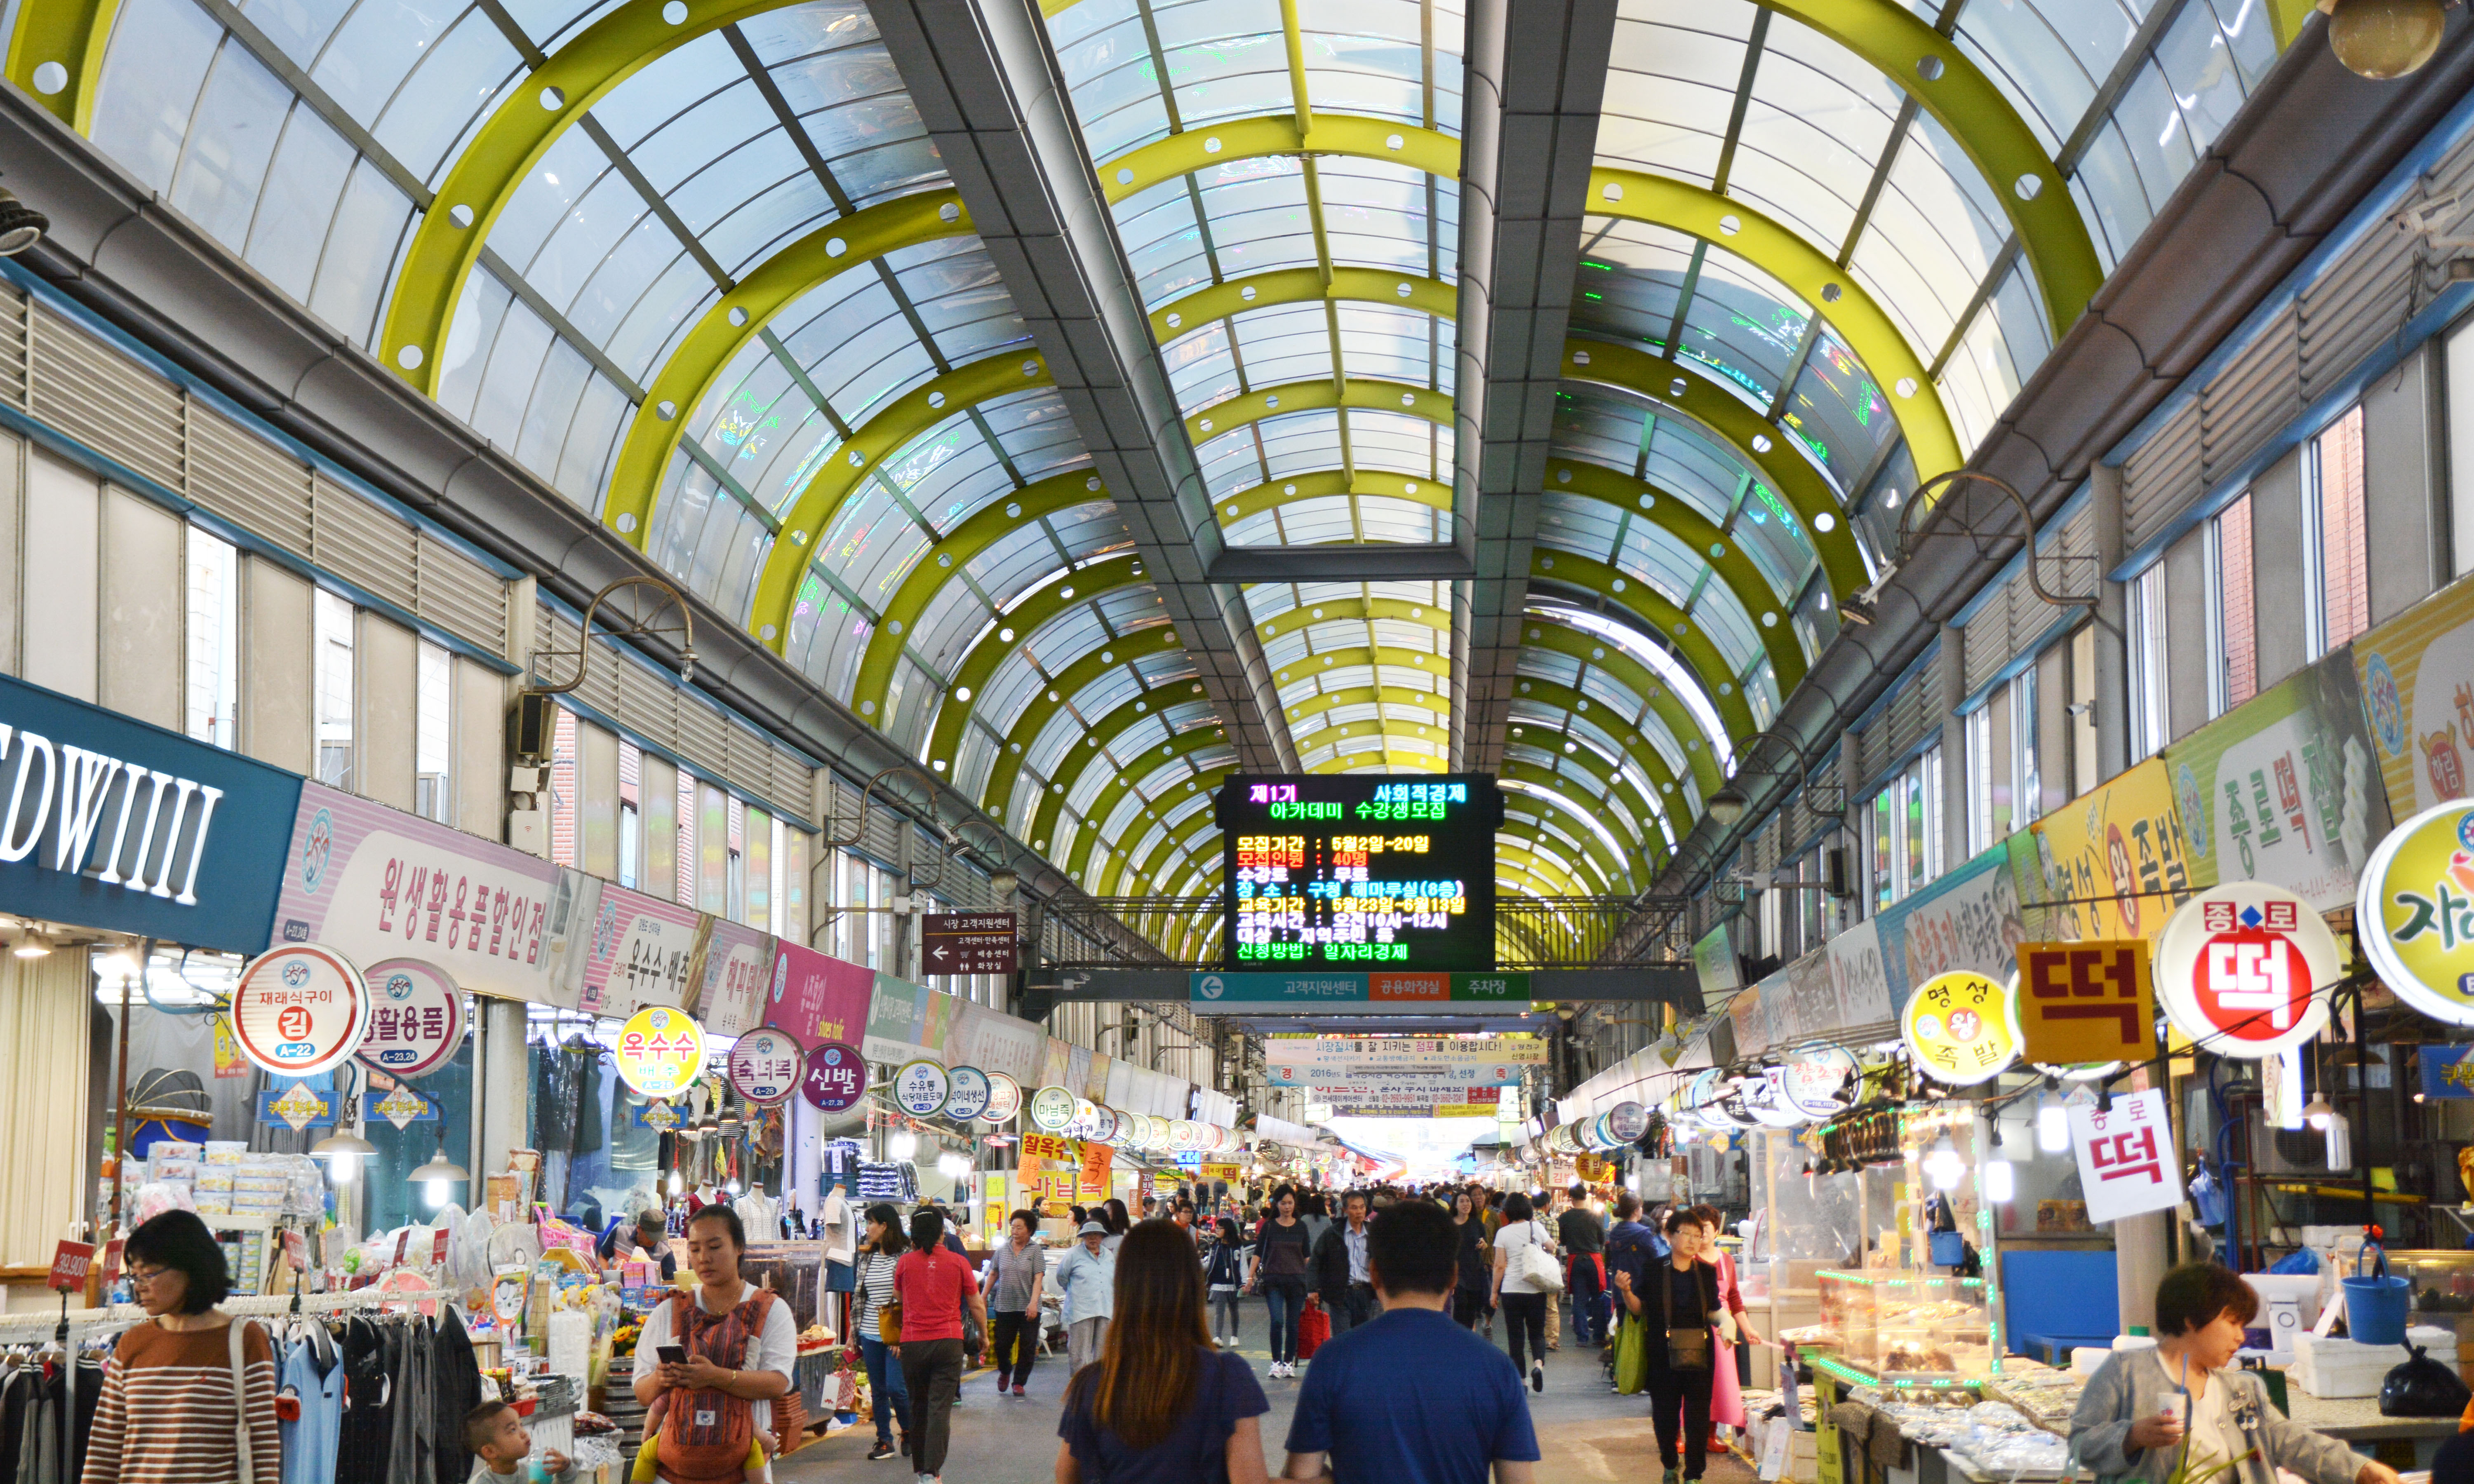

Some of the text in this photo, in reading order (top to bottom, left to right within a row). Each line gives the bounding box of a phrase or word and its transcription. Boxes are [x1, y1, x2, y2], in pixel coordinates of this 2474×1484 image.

[2432, 749, 2460, 793] 하림
[1250, 784, 1466, 803] 제1기 사회적경제
[1270, 802, 1446, 819] 아카데미 수강생모집
[2224, 733, 2342, 878] 종로떡집
[1237, 836, 1305, 852] 모집기간
[1332, 836, 1429, 852] 5월2일~20일
[1237, 852, 1304, 868] 모집인원
[1333, 852, 1367, 868] 40명
[1237, 866, 1289, 883] 수강료
[1333, 867, 1369, 882] 무료
[1308, 882, 1341, 898] 구청
[379, 857, 546, 964] 원생활용품할인점
[1237, 897, 1305, 913] 교육기간
[1332, 897, 1465, 913] 5월23일~6월13일
[943, 918, 1009, 929] 시장 고객지원센터
[1237, 913, 1305, 928] 교육시간
[1333, 913, 1448, 928] 오전10시~12시
[1237, 928, 1272, 943] 대상
[1298, 928, 1366, 944] 지역주민
[1376, 928, 1395, 943] 등
[978, 950, 1009, 958] 배송센터
[1324, 943, 1409, 960] 일자리경제
[726, 955, 768, 1010] 해피데이
[1284, 979, 1506, 994] 고객지원센터 공용화장실 주차장
[2208, 939, 2289, 1029] 떡
[260, 990, 332, 1005] 재래식구이
[2030, 949, 2140, 1044] 떡
[282, 1010, 307, 1038] 김
[1949, 1012, 1977, 1039] 왕
[280, 1045, 312, 1057] A-22
[623, 1033, 695, 1060] 옥수수
[1316, 1041, 1363, 1052] 시장질서를
[1368, 1041, 1377, 1052] 잘
[1383, 1041, 1411, 1052] 지키는
[1416, 1041, 1444, 1052] 점포를
[1450, 1041, 1502, 1052] 이용합시다!
[382, 1052, 417, 1063] A-23,24
[738, 1059, 791, 1080] 숙녀복
[1282, 1068, 1292, 1080] 경
[1310, 1069, 1340, 1078] 2016년도
[1459, 1068, 1475, 1079] 선정
[1496, 1068, 1506, 1079] 축
[644, 1081, 673, 1090] A-25
[810, 1068, 857, 1095] 신발
[909, 1080, 935, 1092] 수유통
[902, 1092, 943, 1102] 식당재료도매
[1039, 1104, 1069, 1117] 마님죽
[1177, 1152, 1201, 1174] 떡
[2088, 1125, 2163, 1184] 떡
[1088, 1152, 1104, 1181] 죽
[1580, 1158, 1603, 1175] 족발
[1031, 1176, 1103, 1198] 마님죽
[1143, 1174, 1153, 1196] 꽈배기
